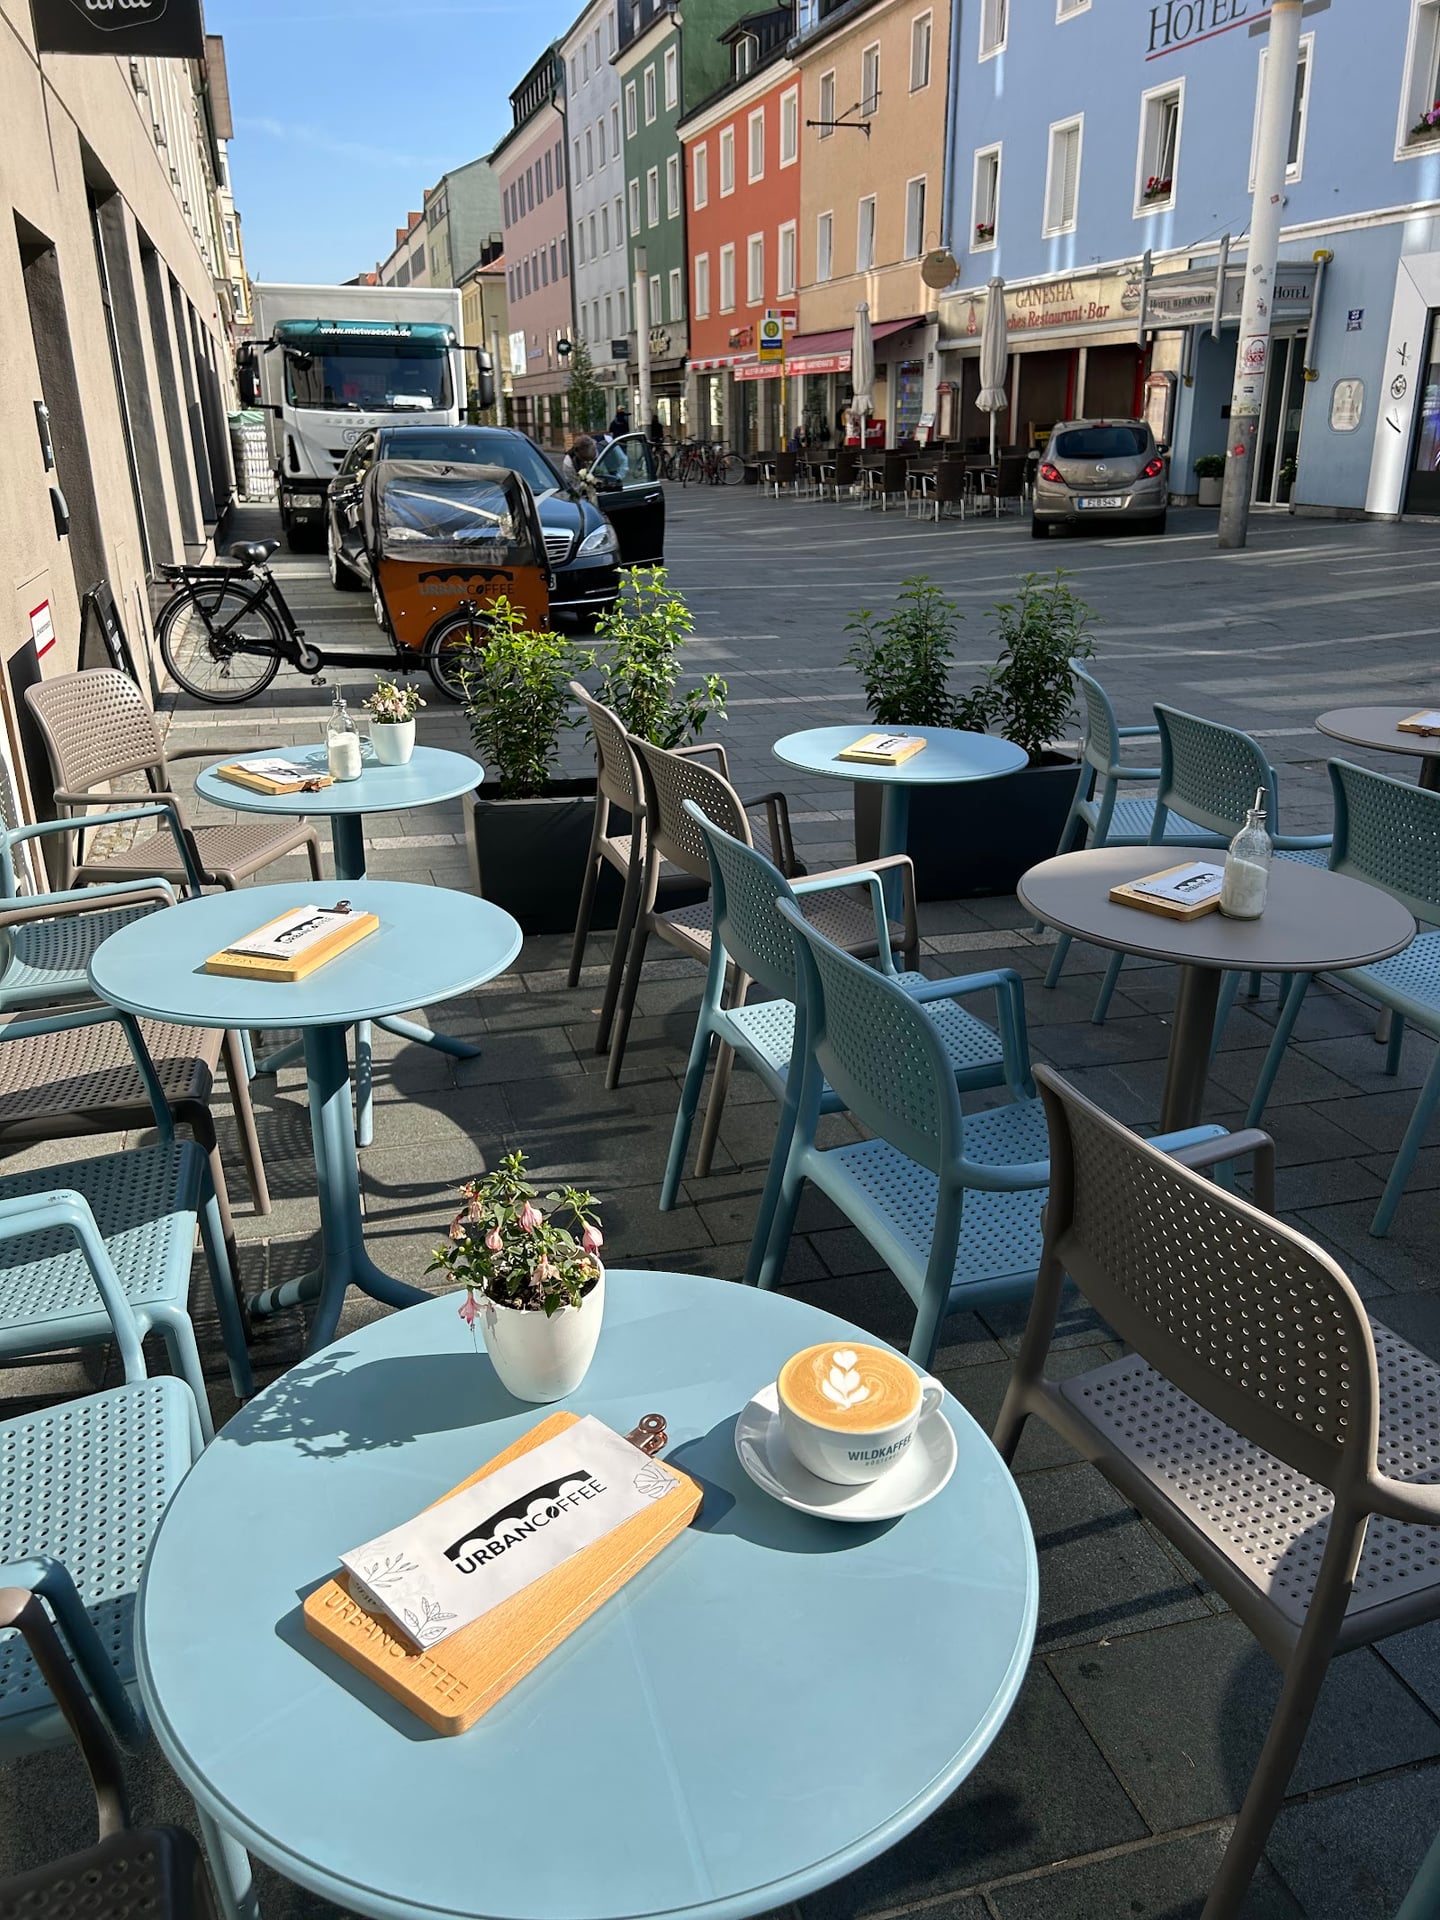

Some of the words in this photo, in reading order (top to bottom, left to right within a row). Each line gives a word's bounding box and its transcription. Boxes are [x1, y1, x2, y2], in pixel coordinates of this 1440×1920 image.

[1015, 281, 1075, 309] GANESHA
[1272, 285, 1310, 300] HOTEL
[320, 326, 412, 338] www.mietwaesche.de
[847, 1431, 913, 1462] WILDKAFFEE
[455, 1479, 608, 1575] URBANCOFFEE
